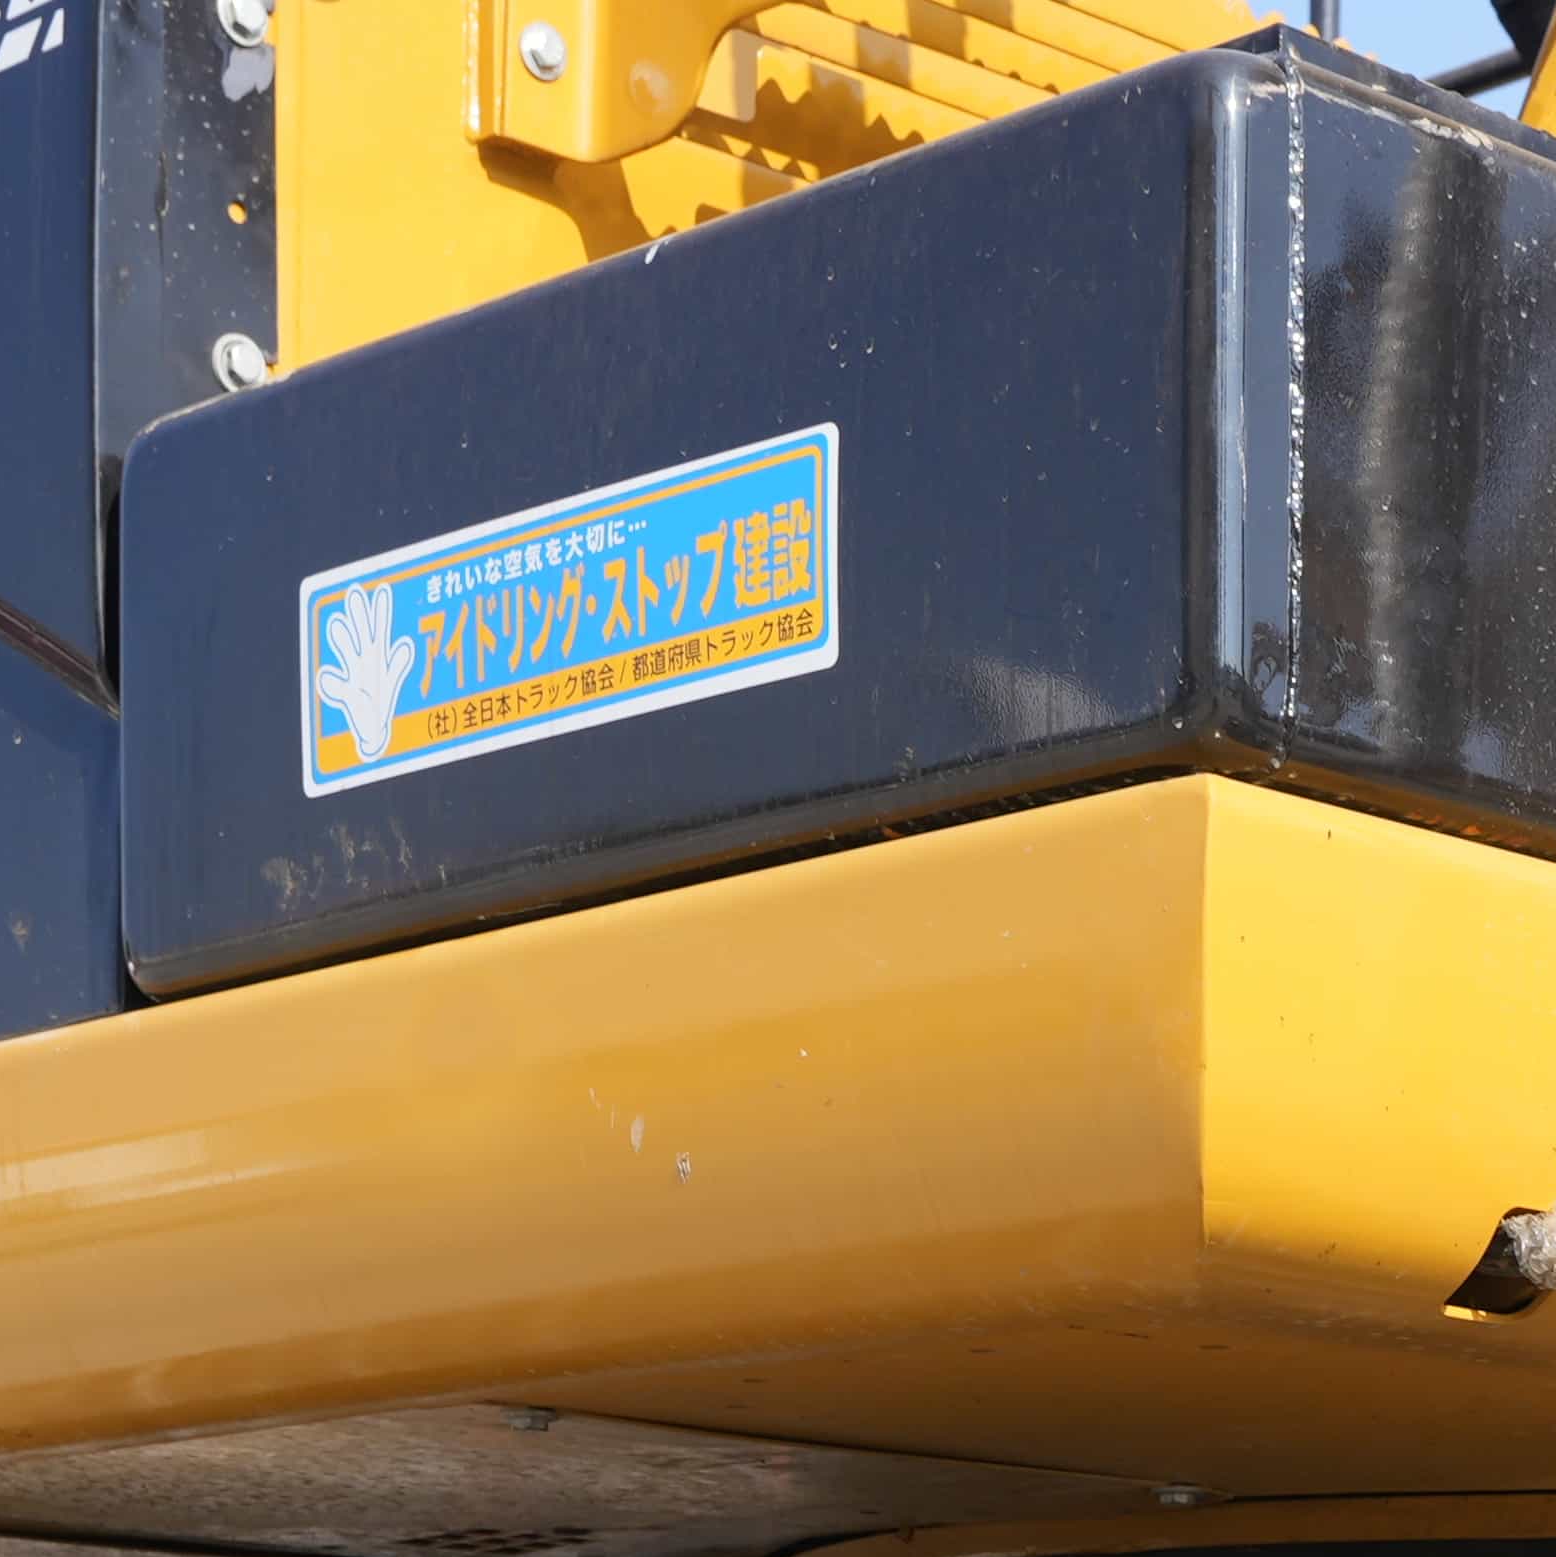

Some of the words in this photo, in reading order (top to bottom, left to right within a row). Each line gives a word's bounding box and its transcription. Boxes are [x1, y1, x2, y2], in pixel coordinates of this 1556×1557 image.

[631, 608, 814, 683] 都道府県トラック協会
